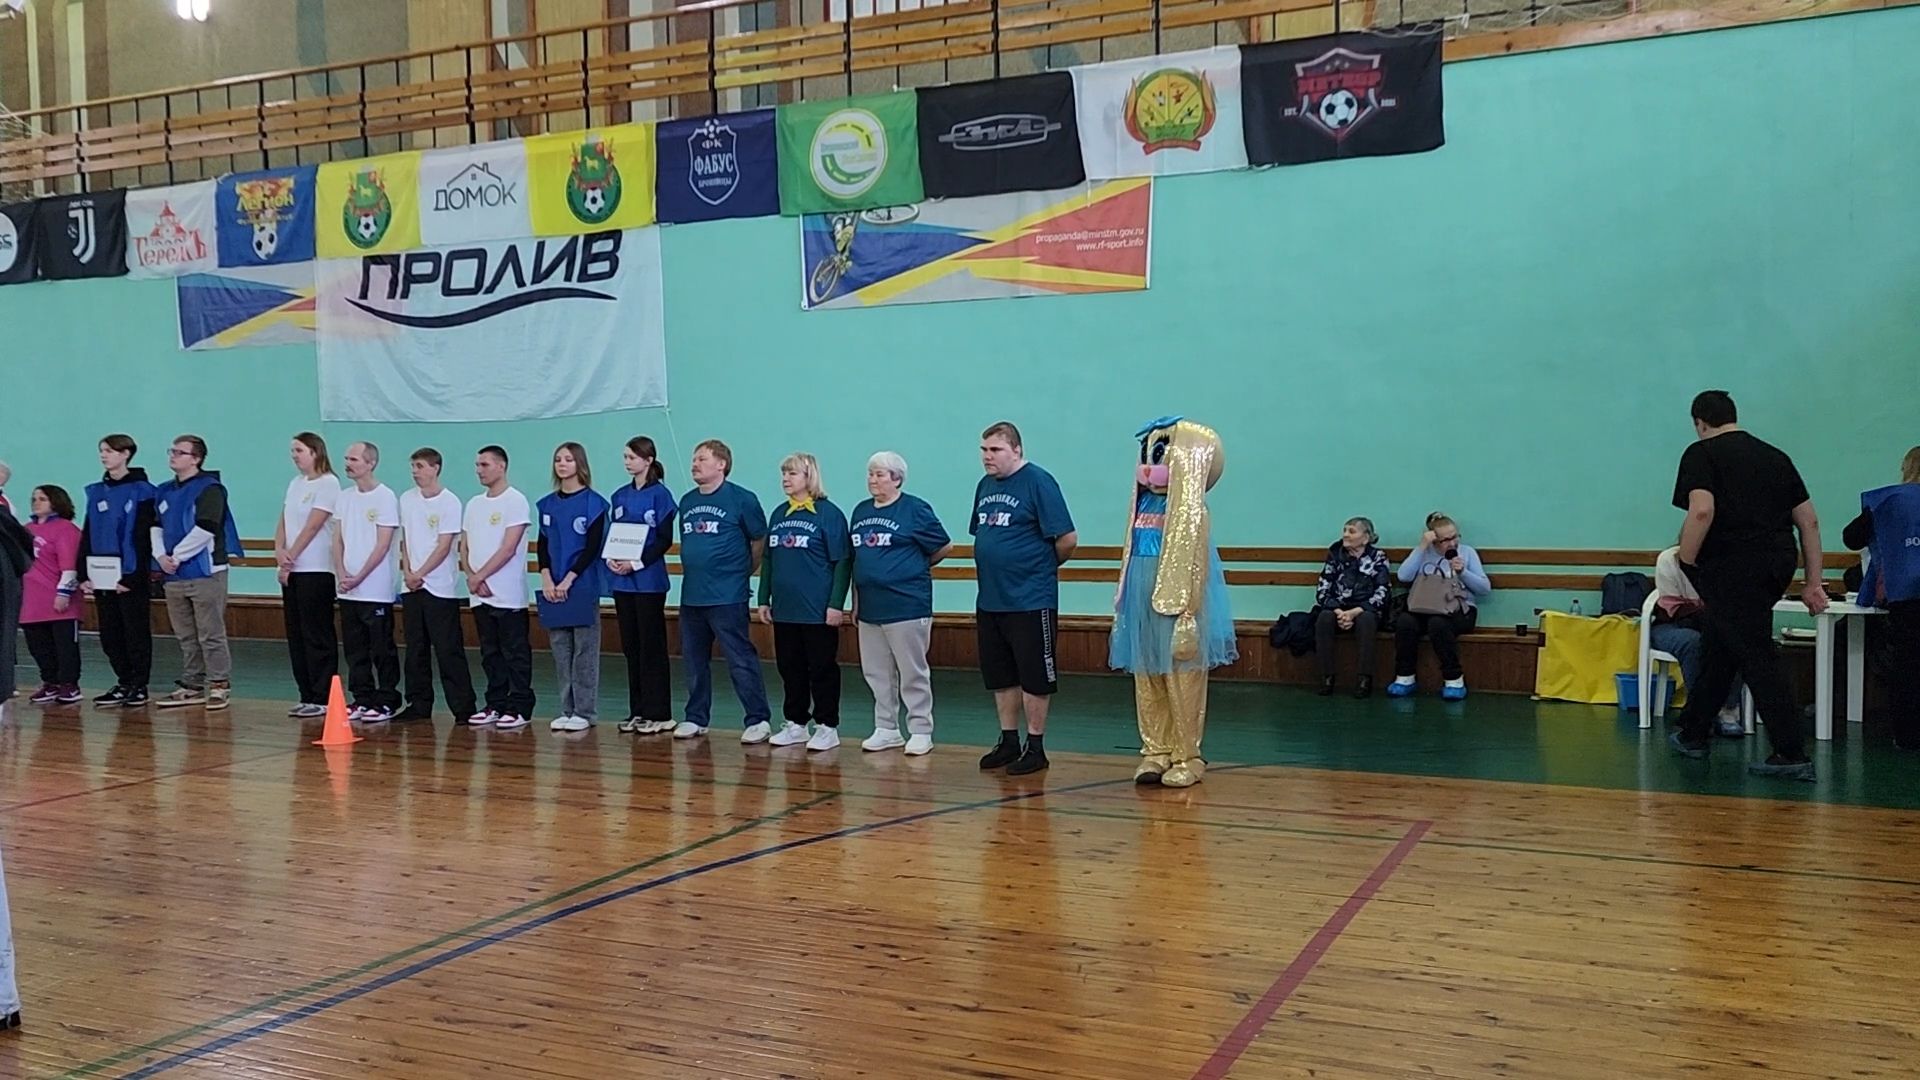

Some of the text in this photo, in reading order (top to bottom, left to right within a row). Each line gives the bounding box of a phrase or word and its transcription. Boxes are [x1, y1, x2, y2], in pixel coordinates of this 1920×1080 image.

[701, 139, 722, 149] ФК
[694, 153, 733, 175] ФАБУС
[433, 182, 517, 212] ДОМОК
[1035, 227, 1145, 244] propaganda@minstm.gov.ru
[1076, 237, 1144, 252] www.rf-sport.info
[358, 229, 623, 300] ПРОЛИВ
